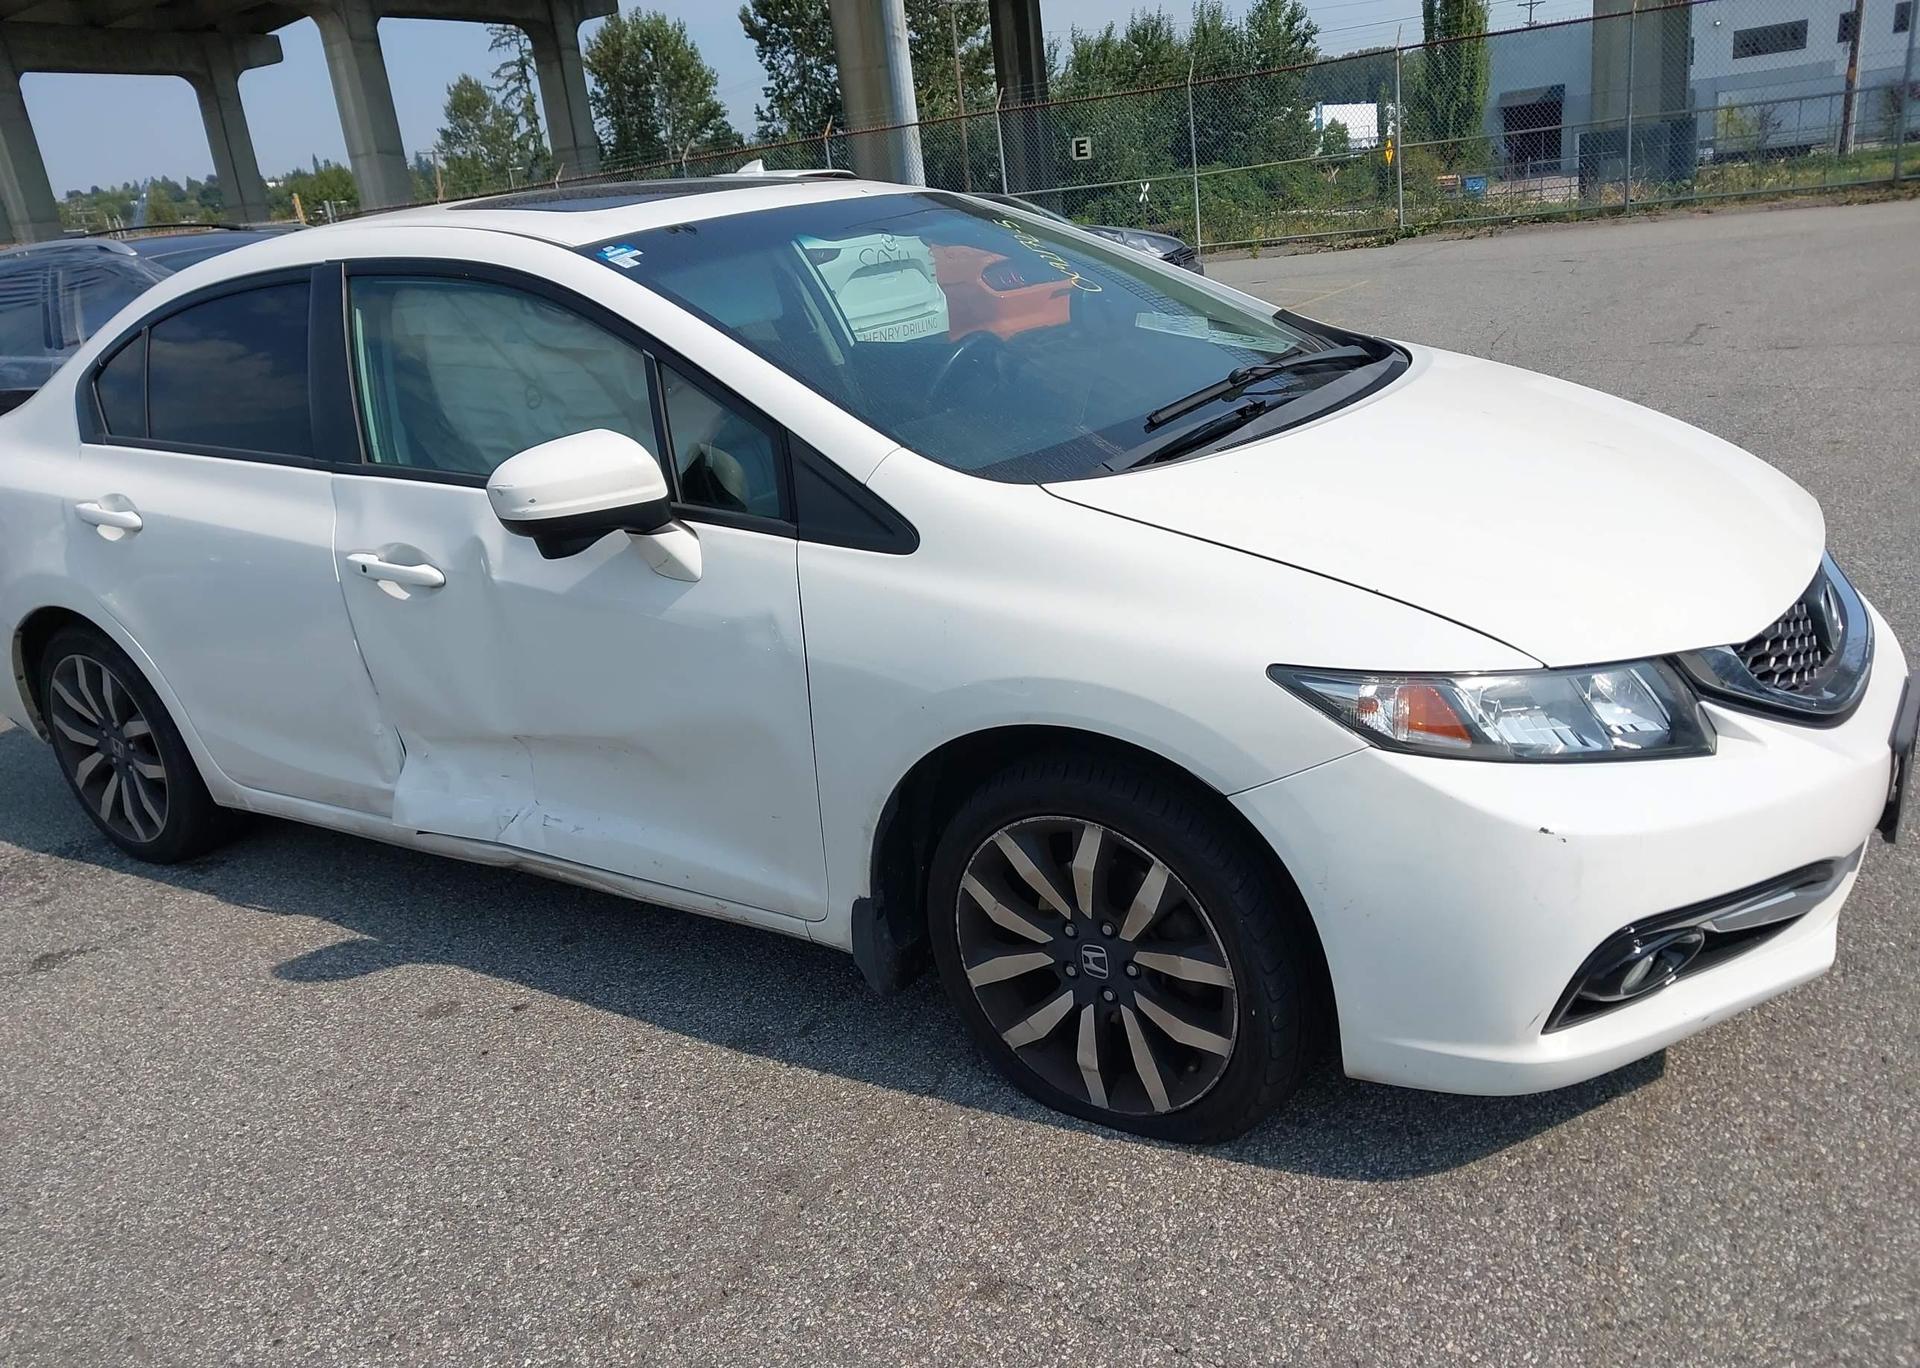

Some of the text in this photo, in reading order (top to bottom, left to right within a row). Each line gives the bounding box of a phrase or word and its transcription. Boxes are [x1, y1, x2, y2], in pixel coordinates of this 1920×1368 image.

[1074, 139, 1089, 158] E
[864, 318, 938, 341] HENRY DRILLING
